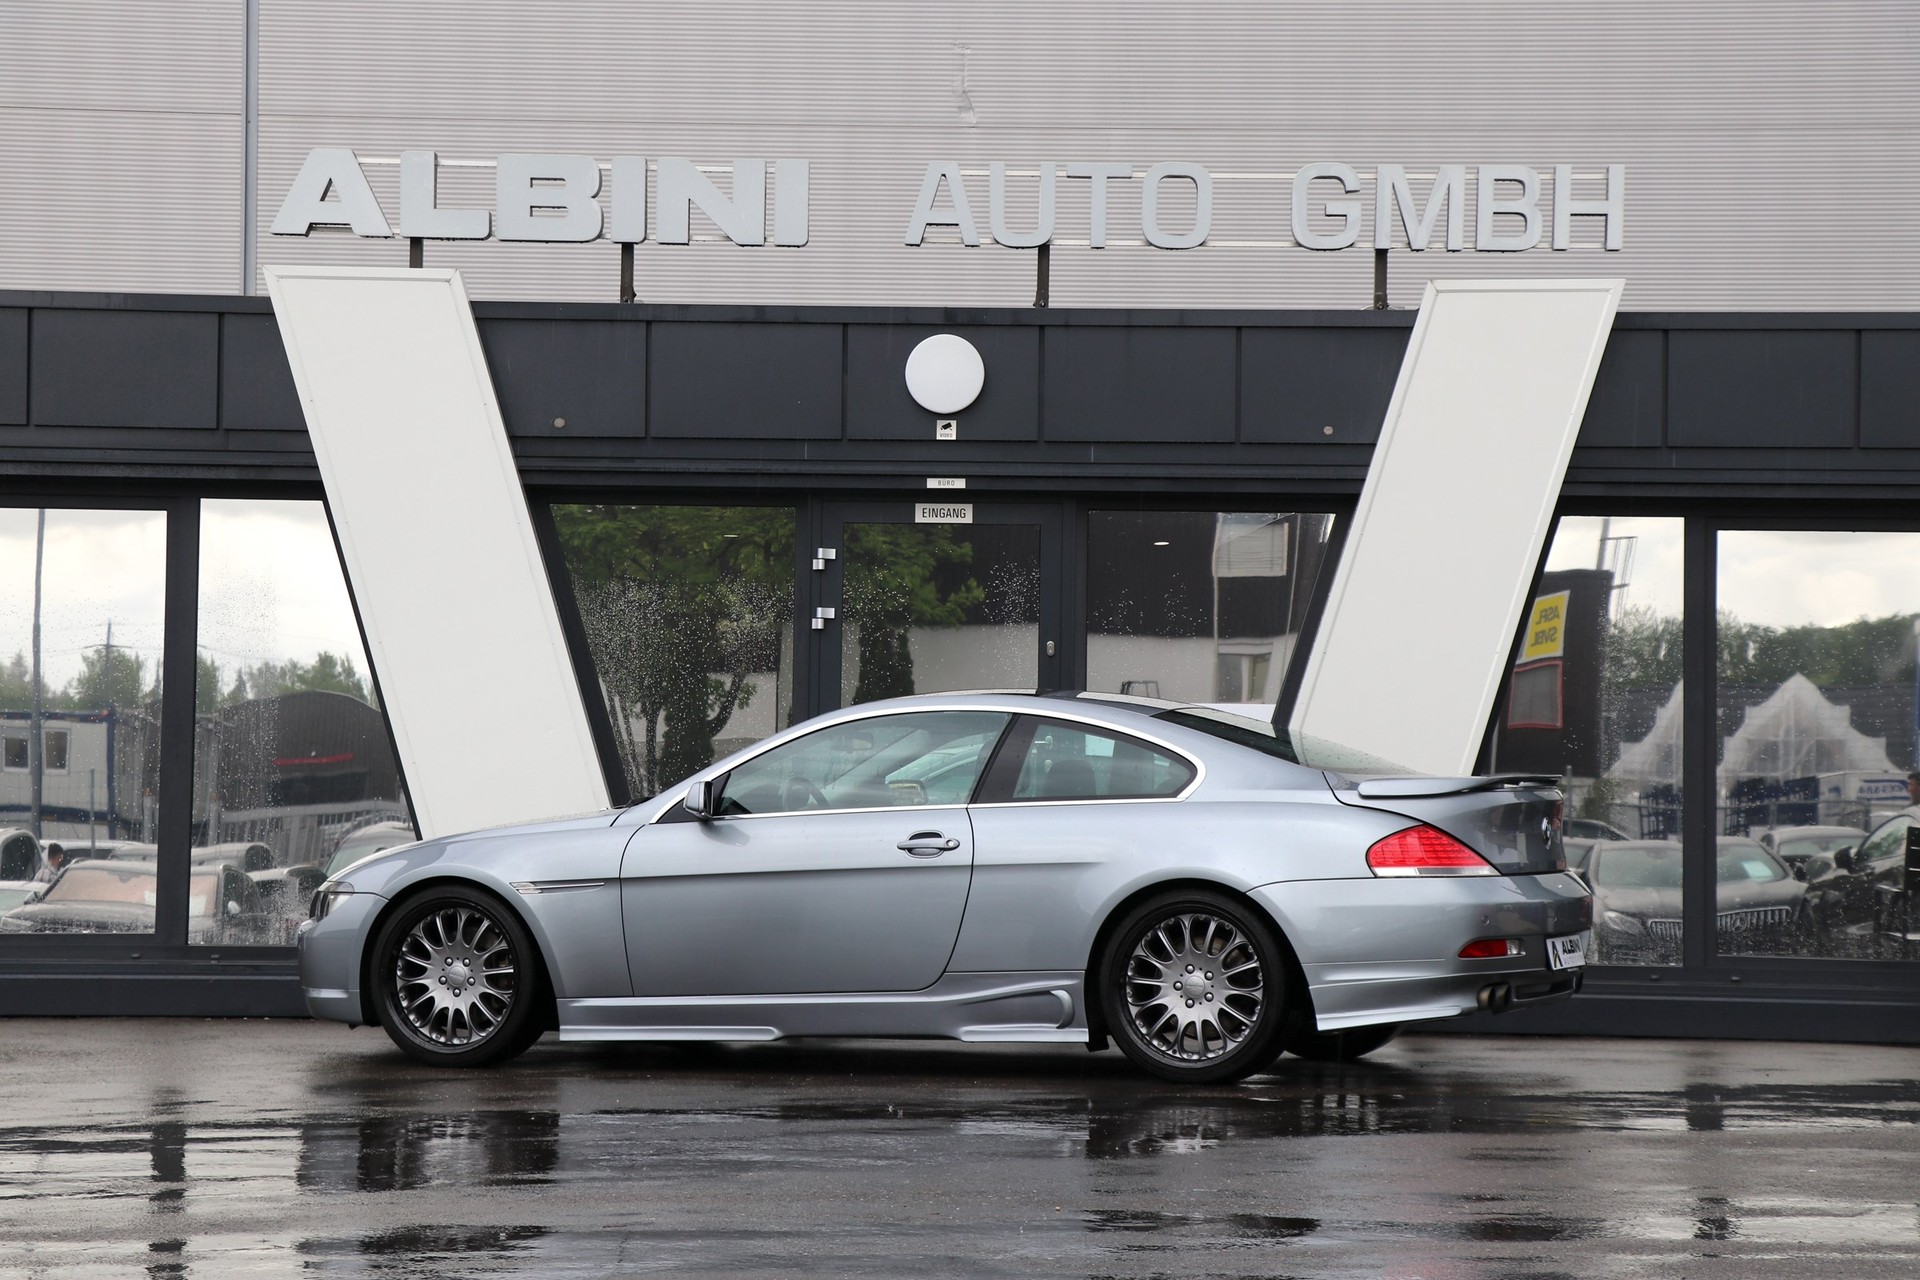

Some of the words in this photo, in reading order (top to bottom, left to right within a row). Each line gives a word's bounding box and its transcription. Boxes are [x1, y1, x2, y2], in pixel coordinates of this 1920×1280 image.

[270, 147, 810, 248] ALBINI
[904, 161, 1214, 250] AUTO
[1290, 161, 1626, 251] GMBH
[922, 507, 967, 519] EINGANG
